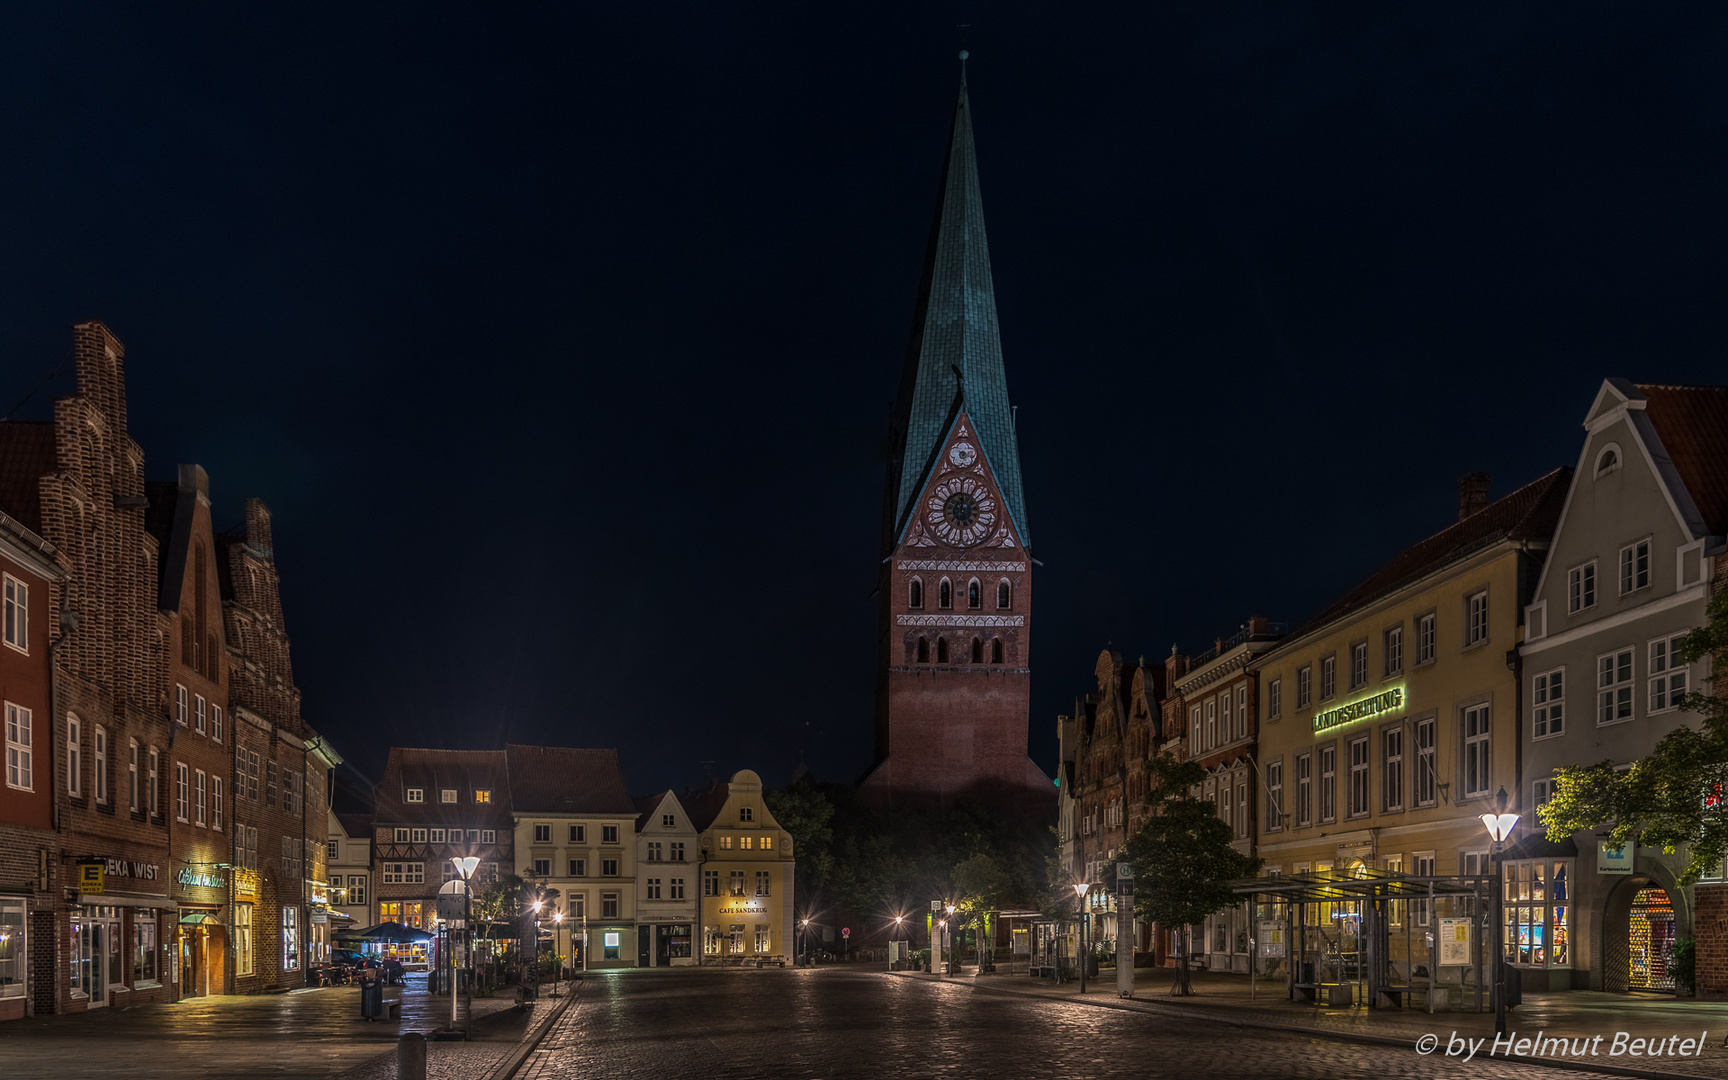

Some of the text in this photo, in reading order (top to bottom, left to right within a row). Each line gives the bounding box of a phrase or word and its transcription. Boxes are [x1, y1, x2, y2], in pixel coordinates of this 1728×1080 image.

[1311, 688, 1402, 732] LANDESZEITUNG
[84, 867, 99, 881] E
[133, 862, 159, 880] WIST
[450, 896, 462, 904] WC
